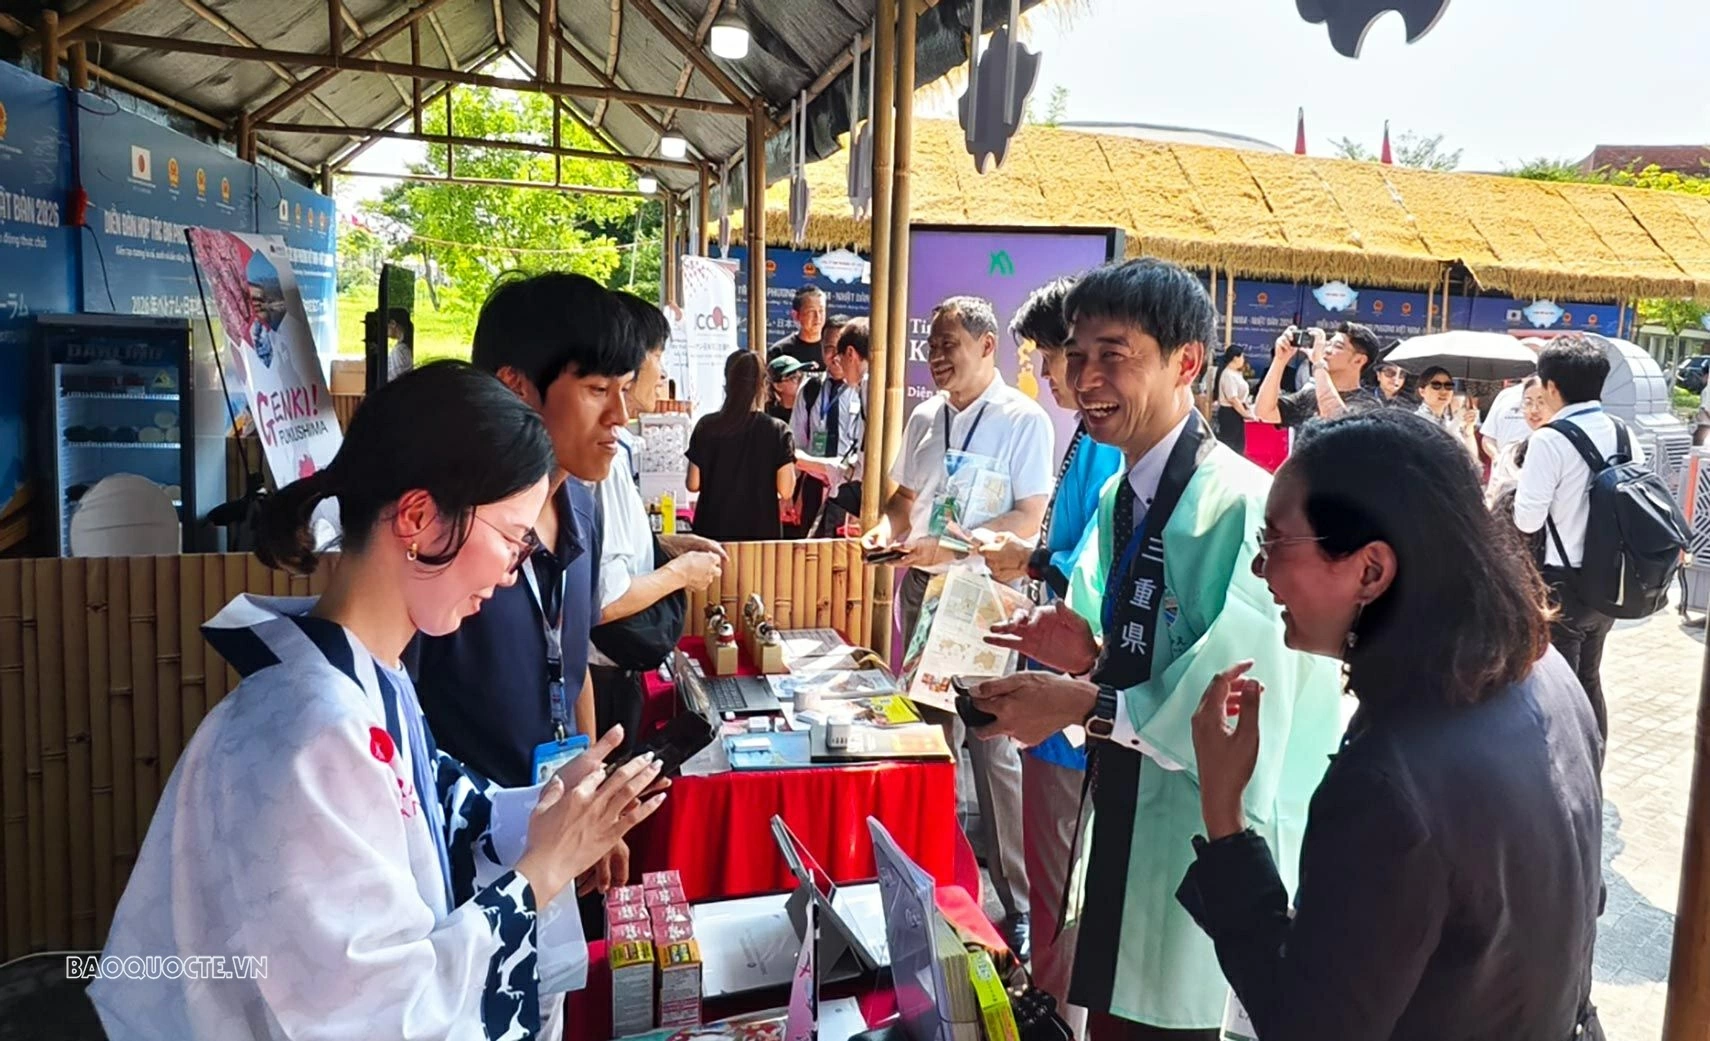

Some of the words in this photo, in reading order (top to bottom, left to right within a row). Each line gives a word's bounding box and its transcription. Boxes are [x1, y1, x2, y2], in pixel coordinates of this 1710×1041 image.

[909, 340, 930, 362] K
[257, 384, 318, 447] GENKI!
[278, 420, 328, 446] FUKUSHIMA
[1120, 537, 1165, 656] 三重県
